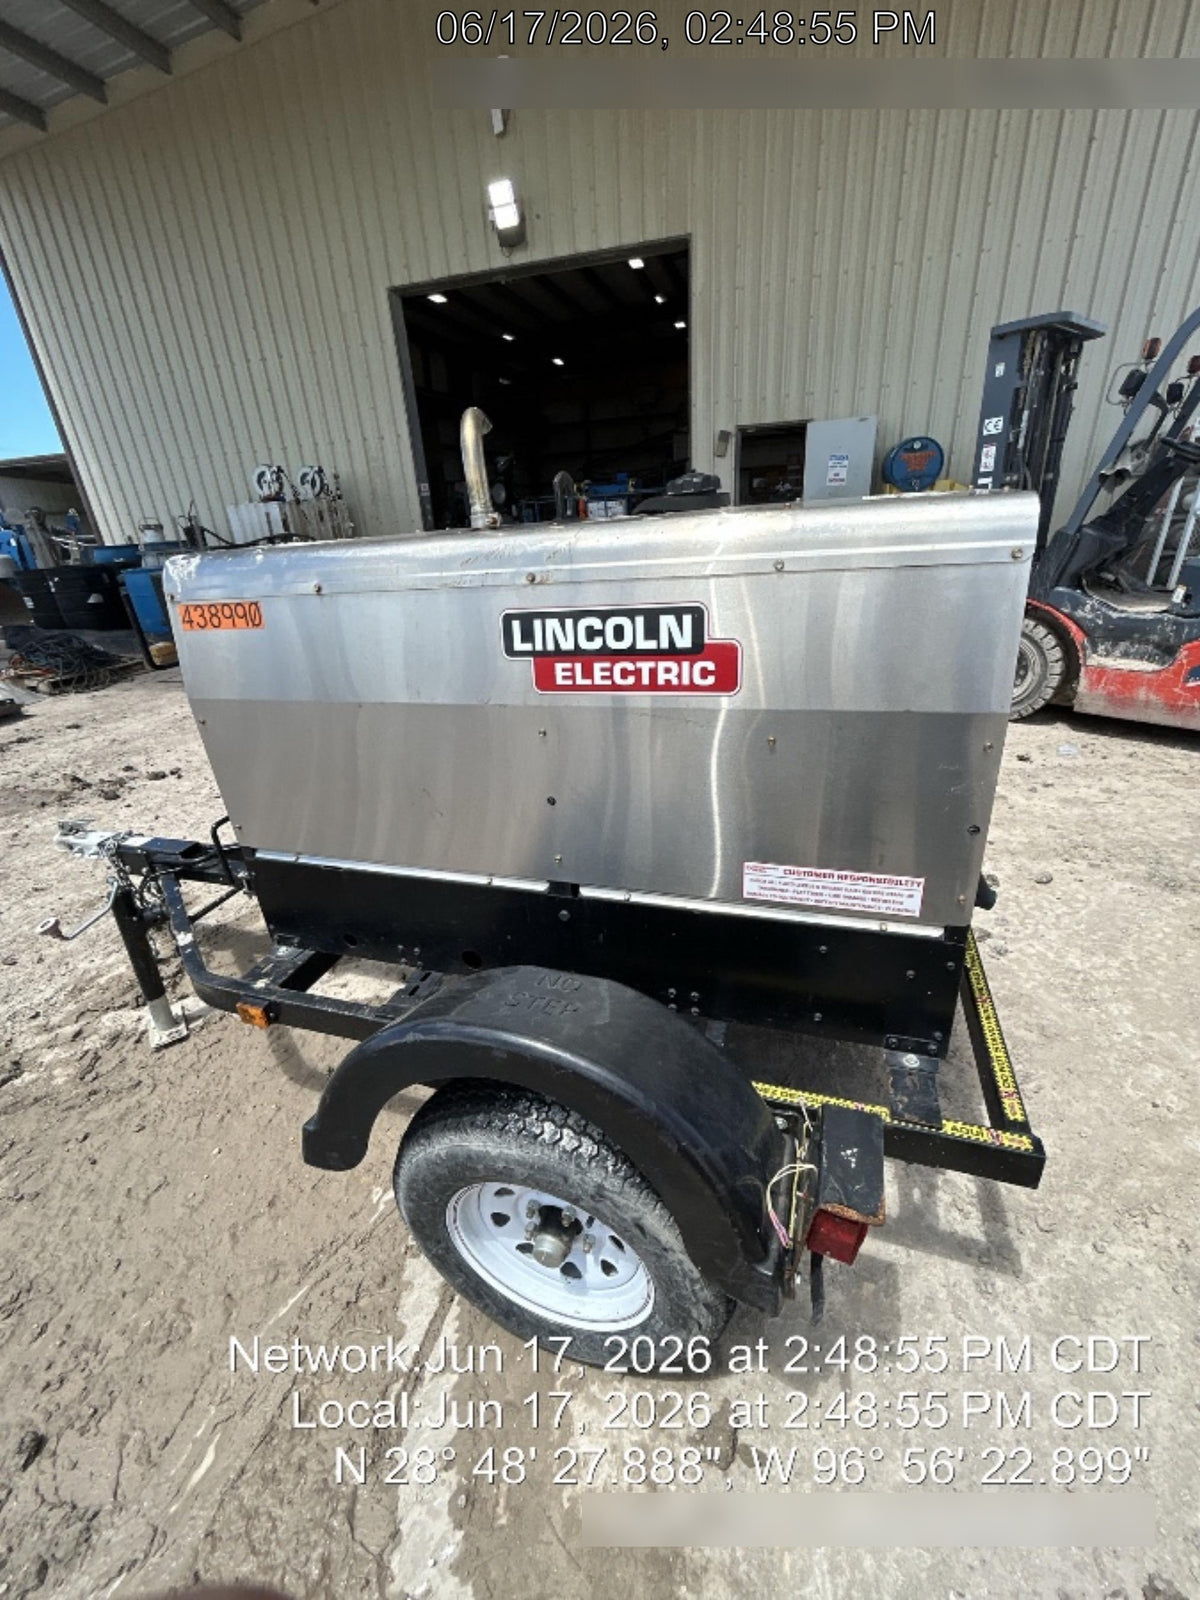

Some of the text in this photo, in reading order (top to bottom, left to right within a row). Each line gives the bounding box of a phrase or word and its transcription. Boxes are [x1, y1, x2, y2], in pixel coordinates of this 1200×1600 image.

[182, 601, 262, 629] 438990
[511, 613, 693, 652] LINCOLN
[554, 661, 716, 686] ELECTRIC
[783, 868, 835, 880] CUSTOMER
[836, 872, 923, 888] RESPONSIBILITY
[535, 974, 584, 992] NO
[504, 991, 580, 1016] STEP
